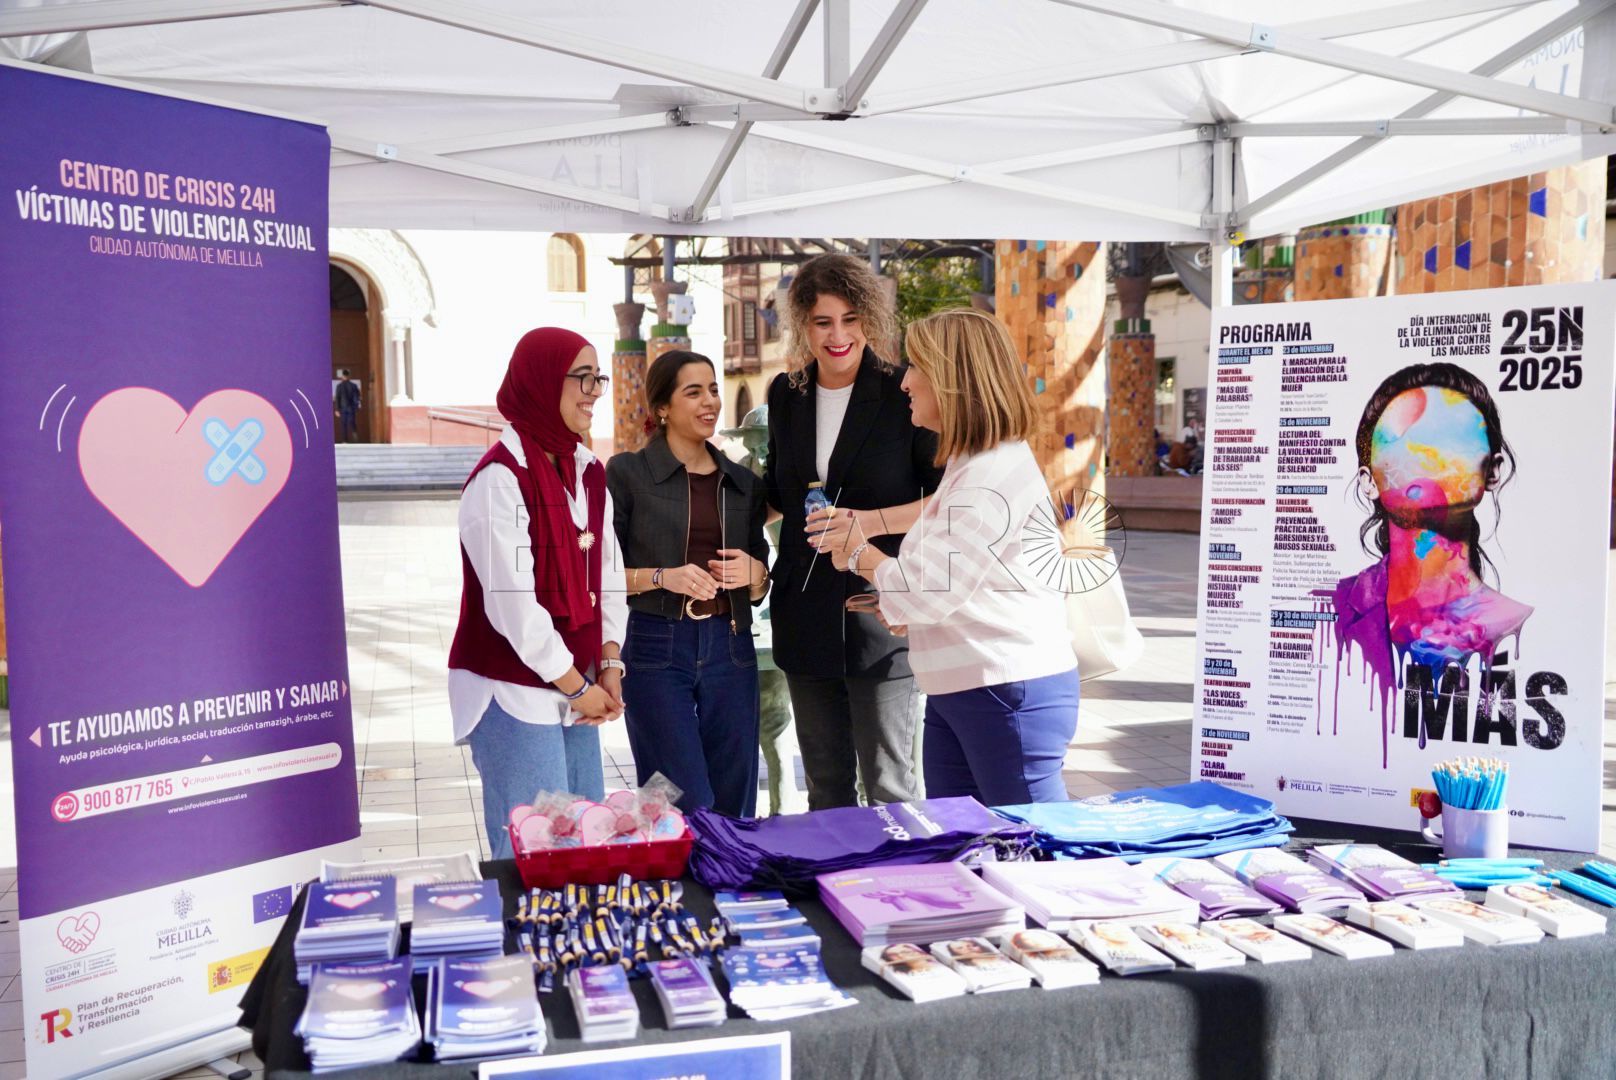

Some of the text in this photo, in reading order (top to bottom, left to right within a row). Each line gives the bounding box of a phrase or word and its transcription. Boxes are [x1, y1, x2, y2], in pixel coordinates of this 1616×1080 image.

[60, 158, 276, 214] CENTRO DE CRISIS 24H
[16, 185, 316, 251] VÍCTIMAS DE VIOLENCIA SEXUAL
[90, 235, 263, 268] CIUDAD AUTÓNOMA DE MELILLA
[1410, 313, 1491, 326] DÍA INTERNACIONAL
[1220, 322, 1312, 344] PROGRAMA
[1398, 322, 1491, 338] DE LA ELIMINACIÓN DE
[1500, 306, 1583, 355] 25N
[1400, 334, 1490, 348] LA VIOLENCIA CONTRA
[1264, 347, 1272, 355] de
[1291, 344, 1333, 354] de NOVIEMBRE
[1432, 345, 1490, 357] LAS MUJERES
[1282, 366, 1325, 374] ELIMINACIÓN
[1499, 355, 1582, 392] 2025
[1296, 418, 1329, 426] NOVIEMBRE
[1278, 439, 1318, 447] MANIFIESTO
[1252, 446, 1268, 454] SALE
[1278, 448, 1287, 456] LA
[1276, 516, 1317, 524] PREVENCIÓN
[1274, 525, 1306, 533] PRÁCTICA
[1292, 612, 1334, 620] de NOVIEMBRE
[1284, 620, 1315, 628] DICIEMBRE
[1284, 643, 1312, 651] GUARIDA
[1220, 690, 1240, 698] VOCES
[1404, 650, 1568, 750] MÁS
[48, 680, 339, 748] TE AYUDAMOS A PREVENIR Y SANAR
[59, 710, 334, 764] Ayuda psicológica, jurídica, social, traducción tamazigh, árabe, etc.
[1217, 730, 1248, 740] NOVIEMBRE
[256, 752, 338, 772] www.infoviolenciasexual.es
[1291, 783, 1322, 792] MELILLA
[84, 778, 173, 812] 900 877 765
[168, 792, 248, 814] www.infoviolenciasexual.es
[158, 925, 212, 949] MELILLA
[45, 964, 72, 976] CENTRO
[46, 974, 66, 984] CRISIS
[77, 976, 184, 1012] Plan de Recuperación,
[78, 994, 154, 1022] Transformación
[79, 1008, 140, 1034] y Resiliencia
